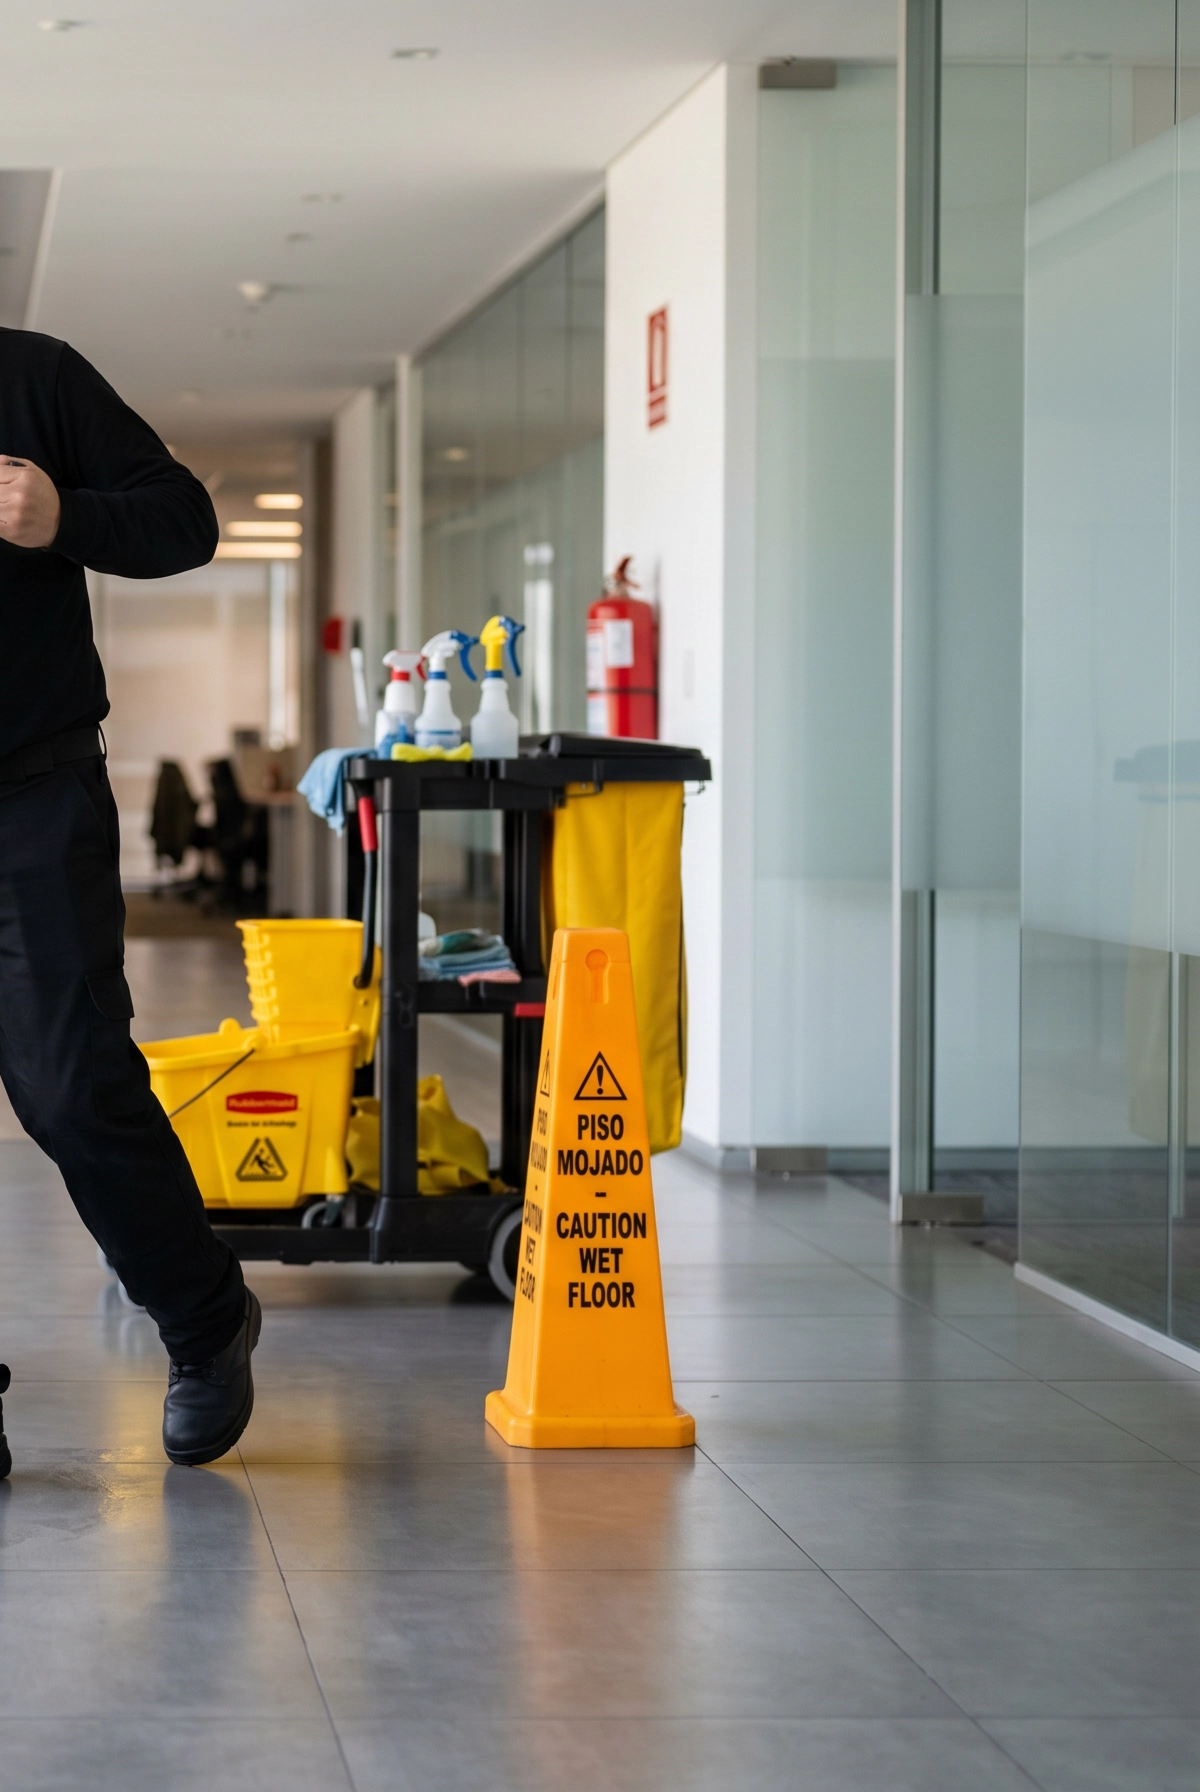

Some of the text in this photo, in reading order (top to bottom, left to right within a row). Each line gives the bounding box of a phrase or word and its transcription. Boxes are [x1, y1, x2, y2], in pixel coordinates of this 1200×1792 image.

[577, 1113, 625, 1141] PISO
[557, 1149, 644, 1176] MOJADO
[556, 1212, 647, 1239] CAUTION
[579, 1247, 624, 1274] WET
[568, 1281, 636, 1309] FLOOR
